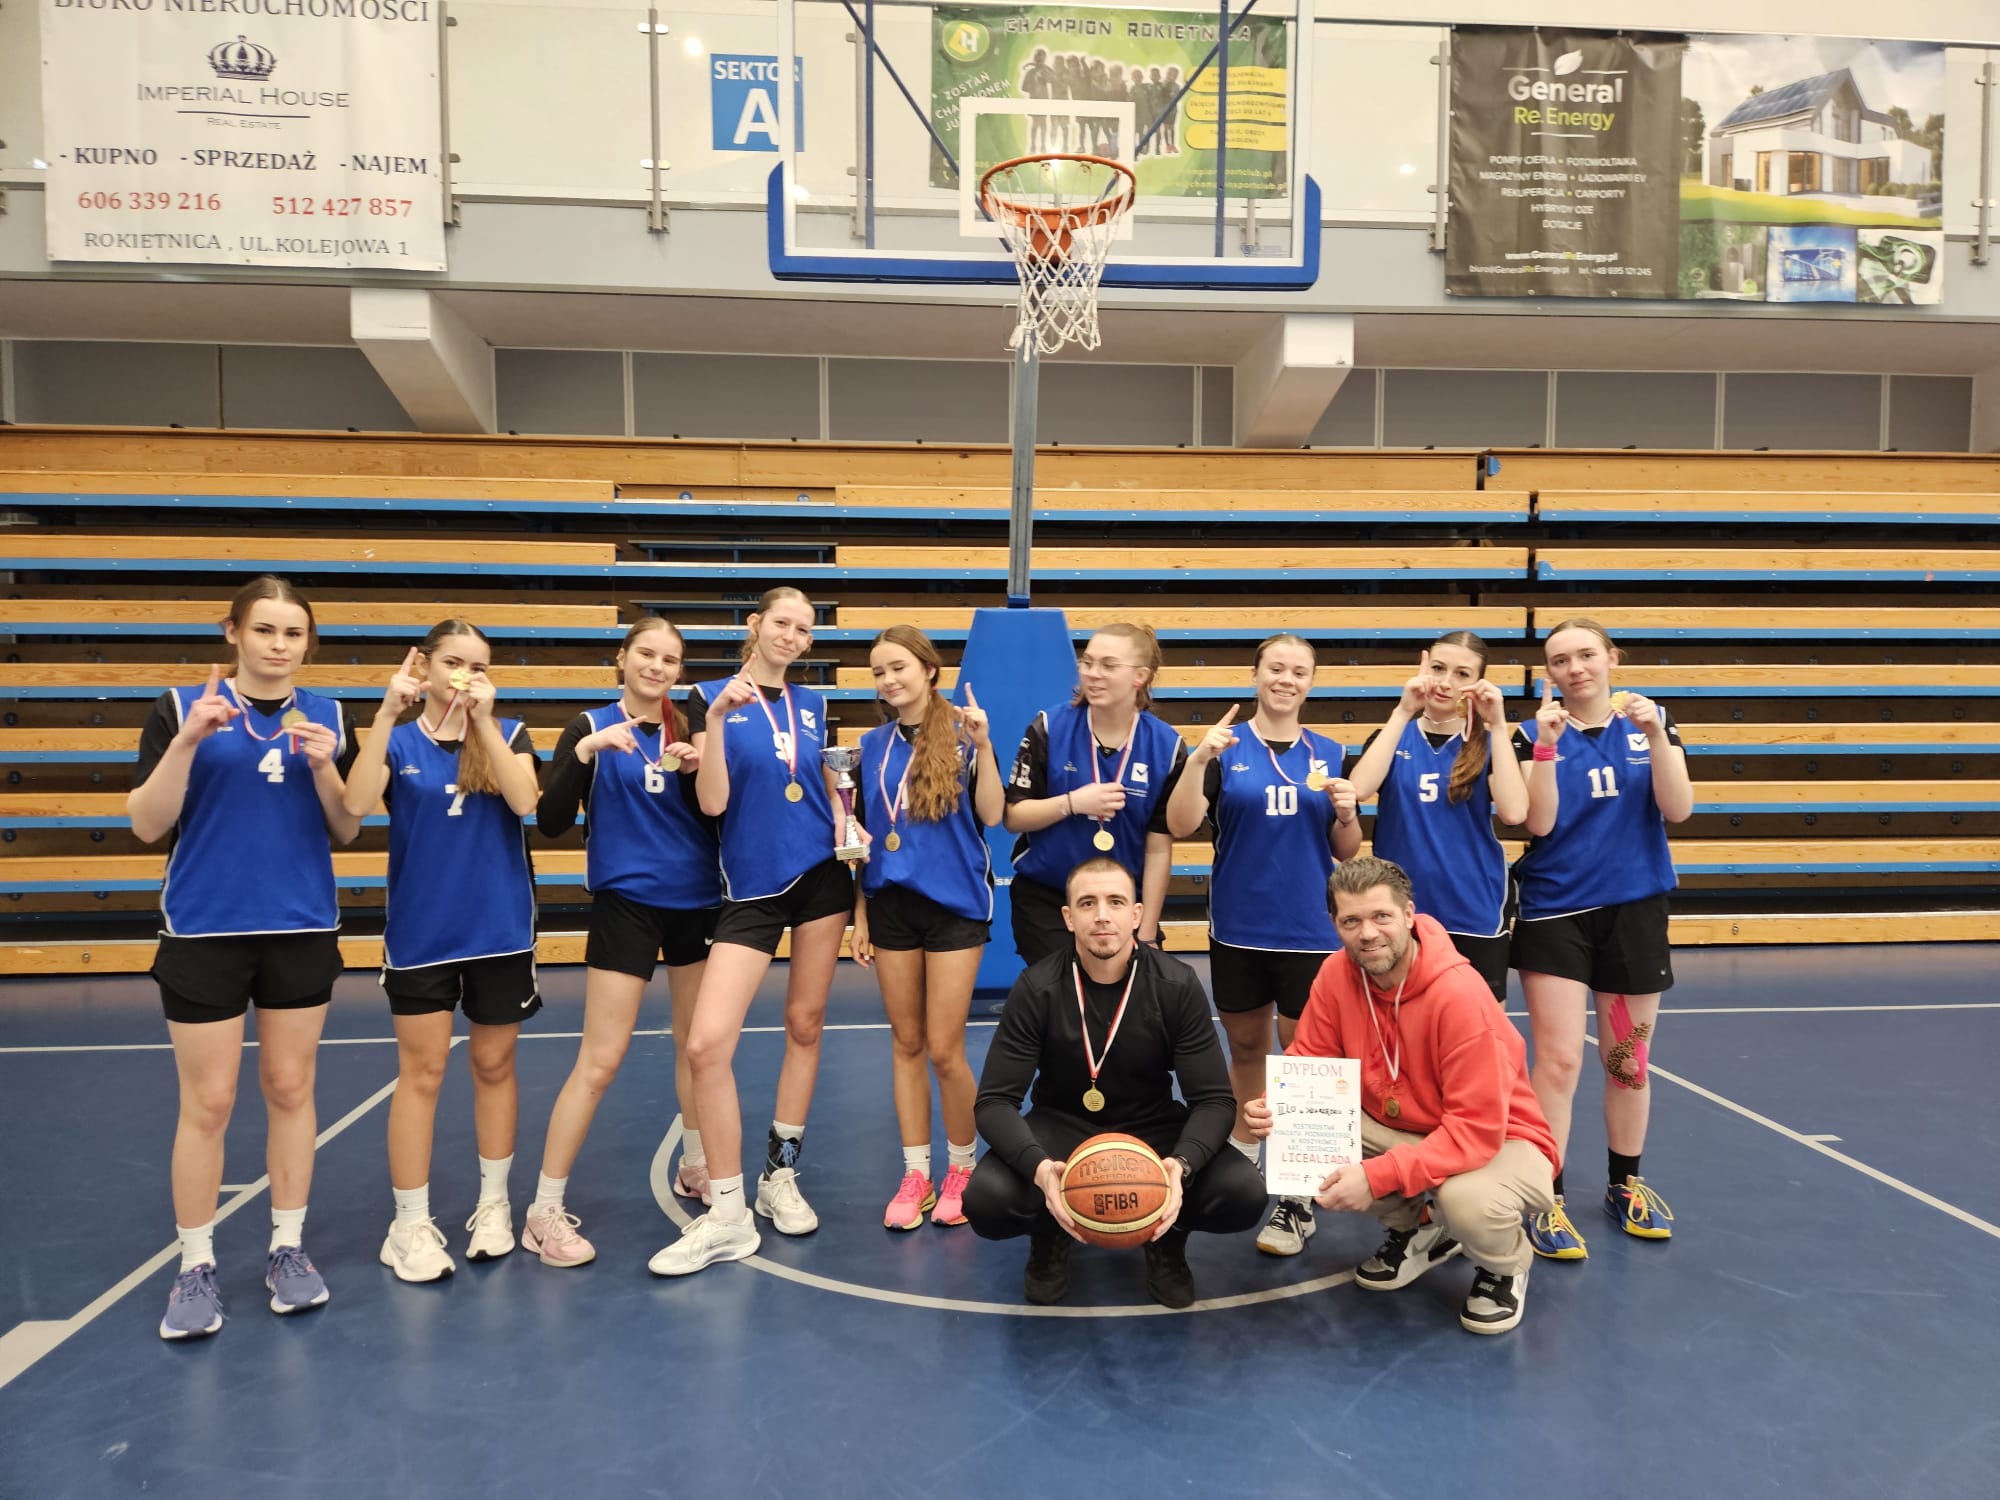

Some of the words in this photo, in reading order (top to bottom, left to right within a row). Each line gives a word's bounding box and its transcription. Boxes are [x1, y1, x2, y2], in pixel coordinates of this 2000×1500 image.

[1005, 17, 1112, 35] CHAMPION
[1127, 22, 1250, 42] ROKIETNA
[137, 83, 252, 104] IMPERIAL
[260, 87, 350, 108] HOUSE
[1507, 75, 1623, 103] General
[207, 117, 237, 128] REAL
[240, 120, 281, 130] ESTATE
[733, 88, 780, 145] A
[74, 147, 158, 166] KUPNO
[193, 149, 317, 171] SPRZEDAŻ
[352, 154, 428, 175] NAJEM
[78, 191, 122, 210] 606
[128, 191, 171, 210] 339
[177, 192, 221, 211] 216
[272, 196, 315, 216] 512
[322, 197, 362, 216] 427
[369, 198, 413, 218] 857
[84, 232, 222, 250] ROKIETNICA
[398, 241, 409, 255] 1
[258, 748, 285, 783] 4
[644, 763, 665, 793] 6
[1419, 773, 1440, 802] 5
[1587, 766, 1619, 799] 11
[445, 784, 466, 816] 7
[1265, 785, 1298, 816] 10
[1282, 1062, 1343, 1077] DYPLOM
[1282, 1153, 1351, 1165] LICEALIADA
[1104, 1191, 1138, 1210] FIBA
